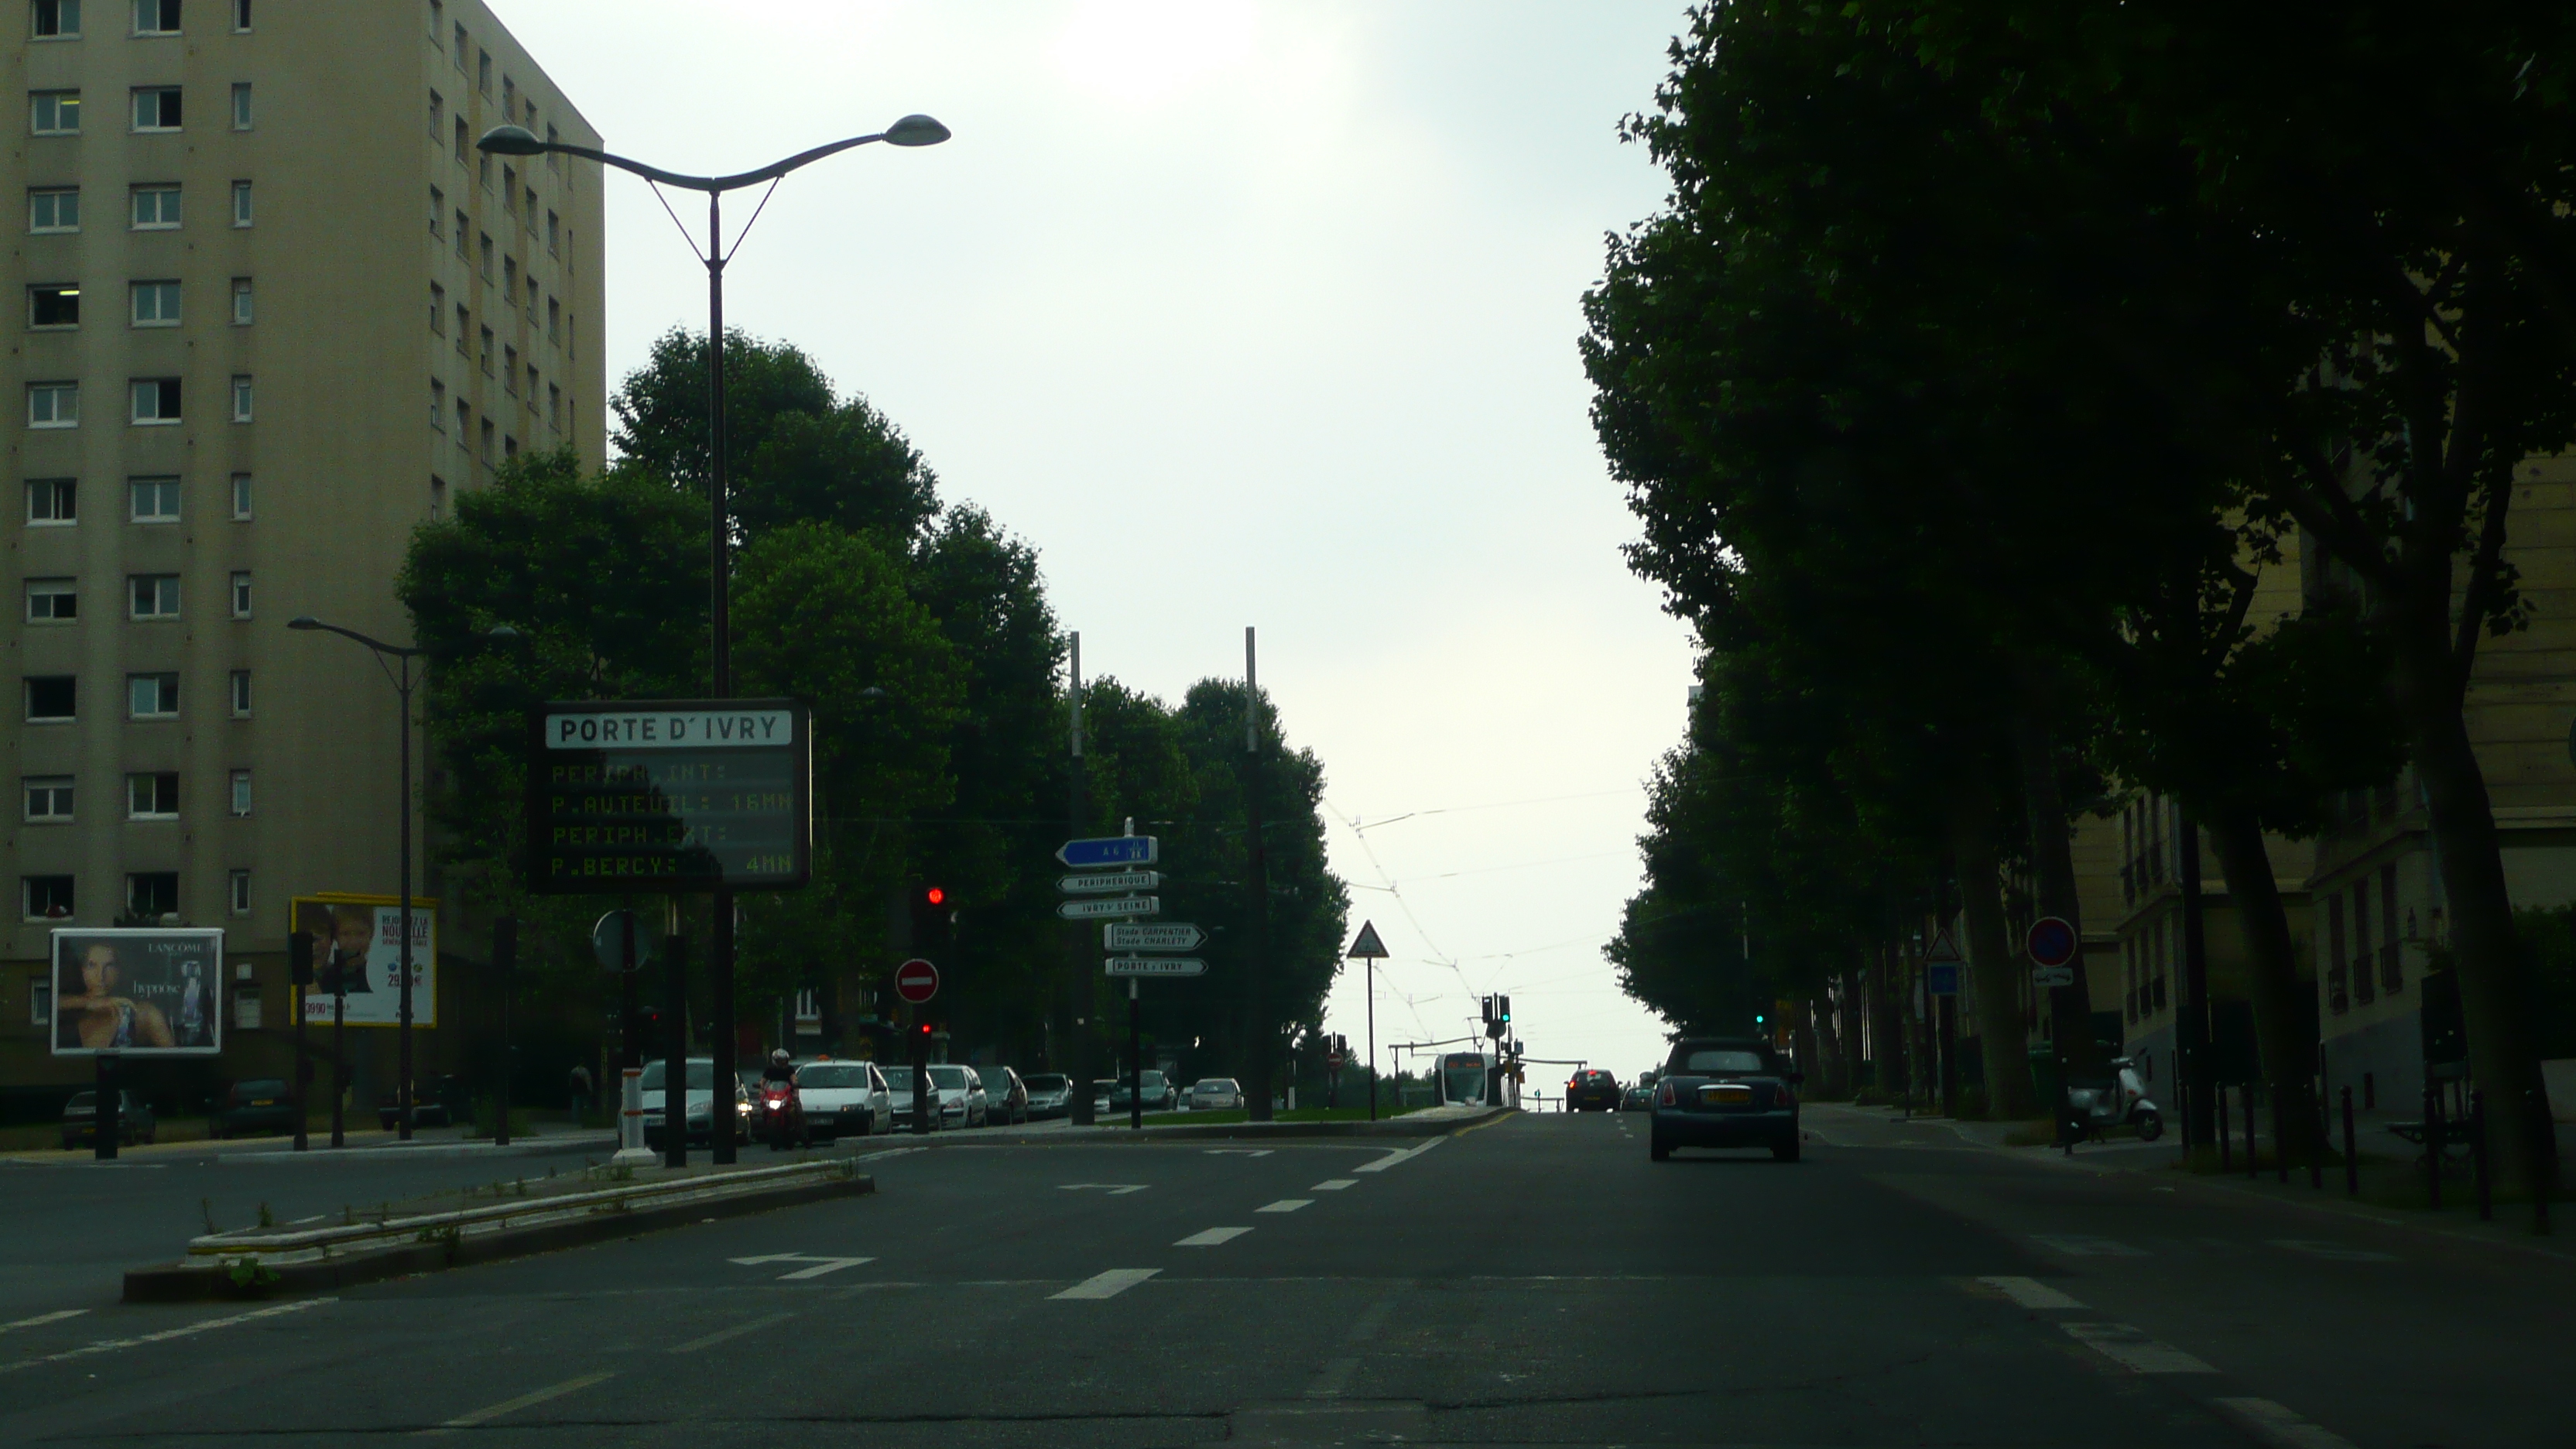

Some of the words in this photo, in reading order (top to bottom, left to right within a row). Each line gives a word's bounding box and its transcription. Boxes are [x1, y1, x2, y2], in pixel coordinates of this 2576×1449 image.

[560, 717, 656, 742] PORTE
[1082, 903, 1105, 913] IVRY
[1117, 901, 1147, 911] SEINE
[382, 925, 428, 937] NOULLE
[1116, 927, 1139, 936] Stade
[1142, 927, 1191, 936] CARPENTIER
[1116, 937, 1140, 945] Stade
[1118, 961, 1149, 970] PORTE
